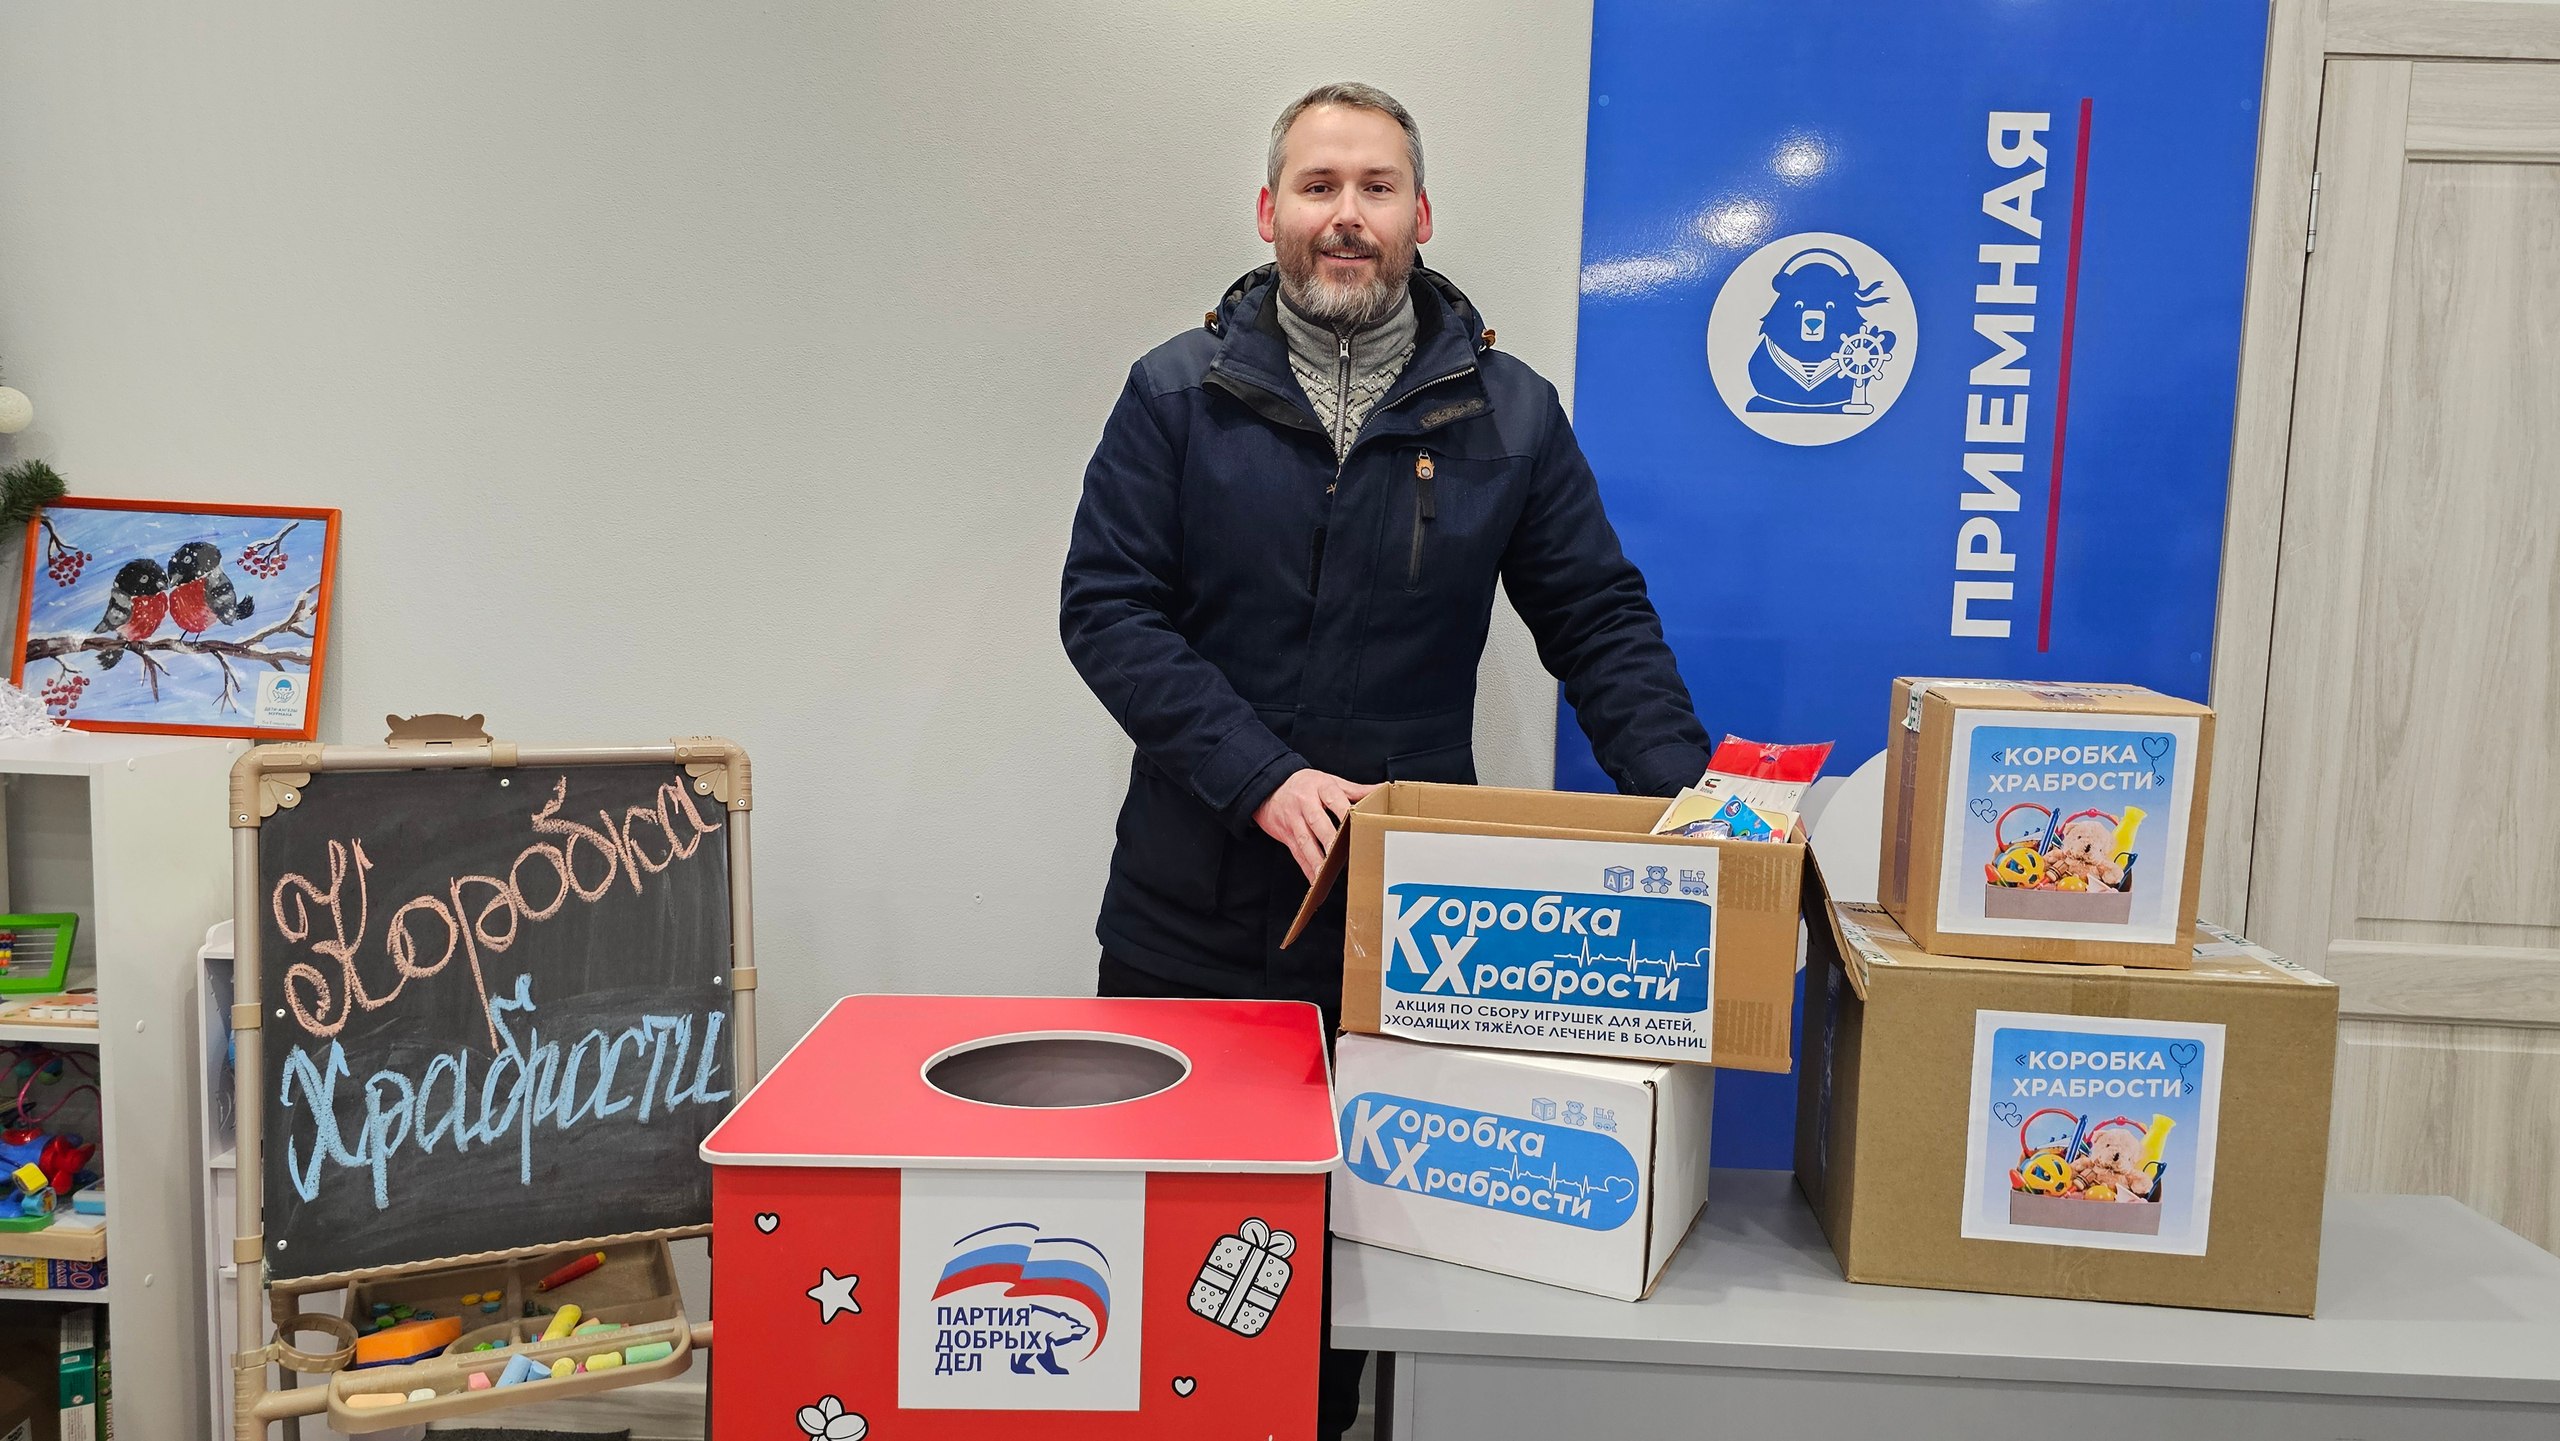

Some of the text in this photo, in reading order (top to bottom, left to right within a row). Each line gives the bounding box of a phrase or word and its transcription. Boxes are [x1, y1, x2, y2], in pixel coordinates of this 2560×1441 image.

[1951, 111, 2050, 638] ПРИЕМНАЯ
[1991, 744, 2138, 766] «КОРОБКА
[1987, 771, 2166, 793] ХРАБРОСТИ»
[273, 775, 722, 1055] Коробка
[1384, 893, 1622, 975] Коробка
[1421, 934, 1680, 1001] Храбрости
[1395, 1000, 1697, 1033] АКЦИЯ ПО СБОРУ ИГРУШЕК ДЛЯ ДЕТЕЙ,
[1475, 1020, 1545, 1036] ТЯЖЁЛОЕ
[1549, 1026, 1616, 1042] ЛЕЧЕНИЕ
[1620, 1032, 1629, 1043] В
[2015, 1050, 2166, 1071] «КОРОБКА
[280, 973, 731, 1211] Храбрости
[2011, 1077, 2194, 1098] ХРАБРОСТИ»
[1348, 1099, 1545, 1170] Коробка
[1384, 1137, 1592, 1220] Храбрости
[937, 1307, 1031, 1326] ПАРТИЯ
[935, 1330, 1042, 1353] ДОБРЫХ
[934, 1353, 982, 1376] ДЕЛ
